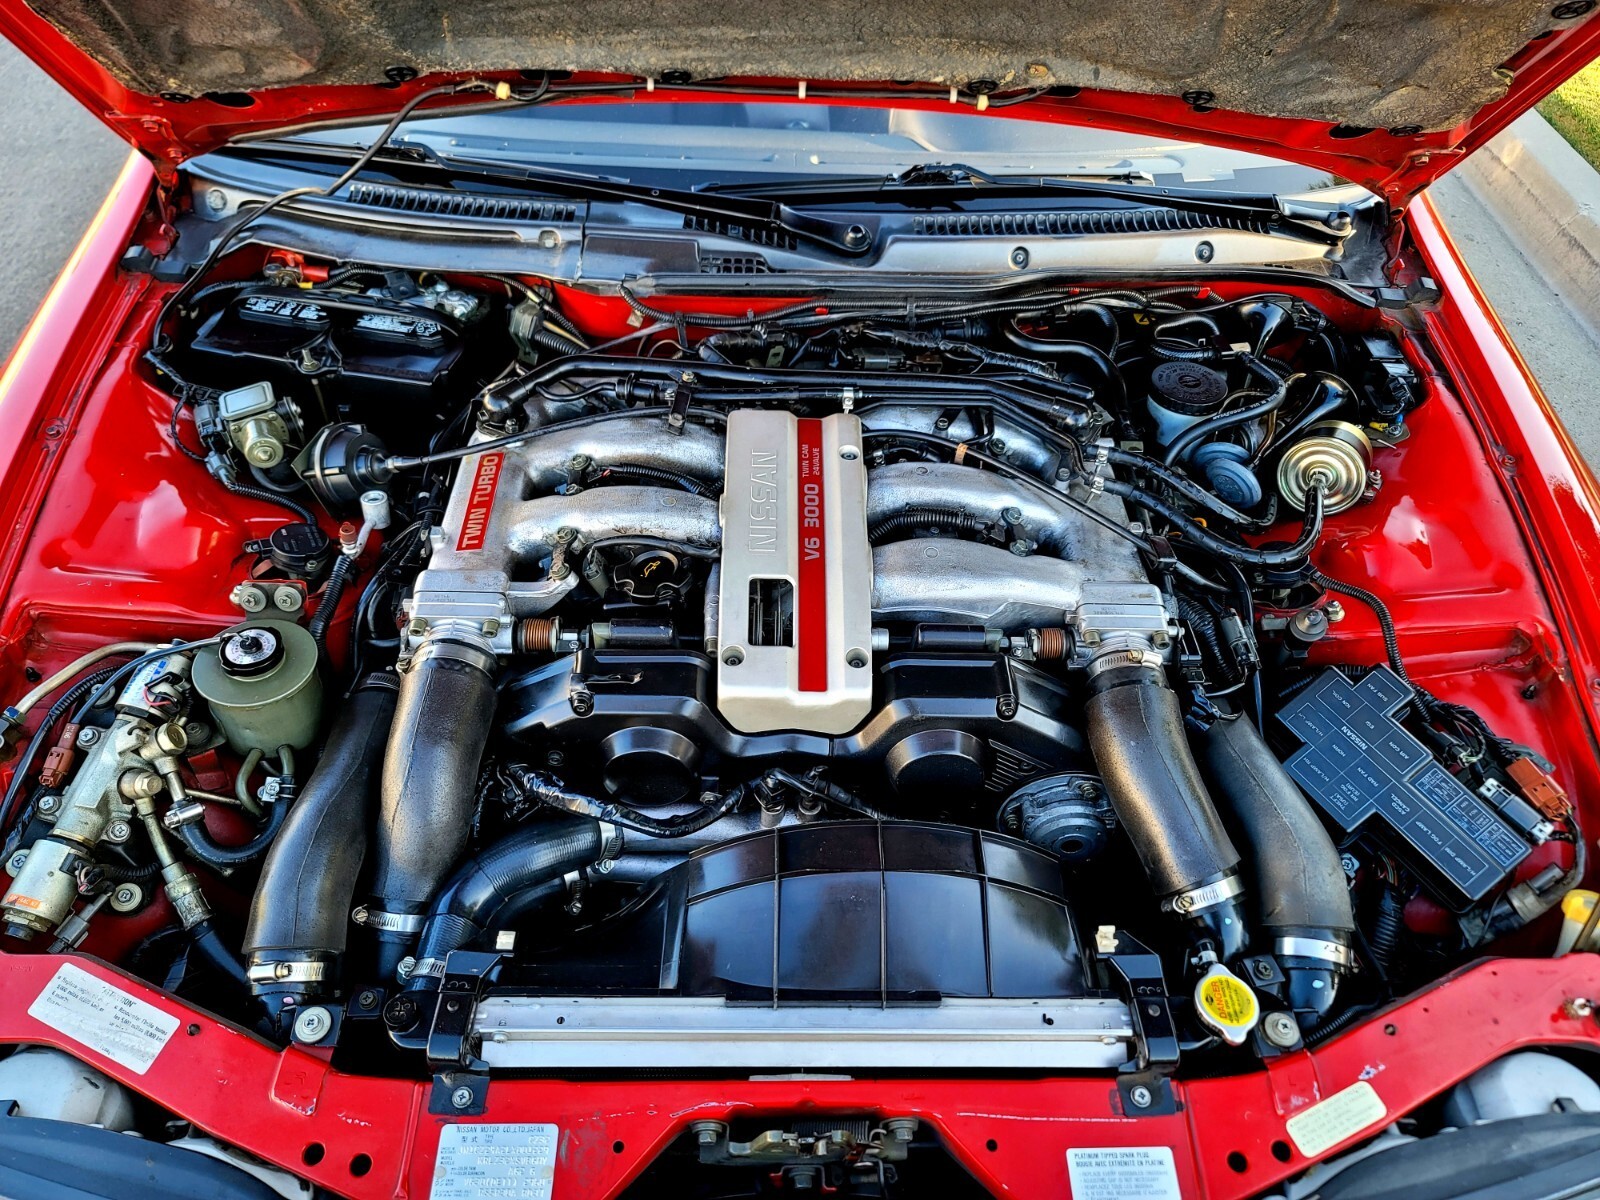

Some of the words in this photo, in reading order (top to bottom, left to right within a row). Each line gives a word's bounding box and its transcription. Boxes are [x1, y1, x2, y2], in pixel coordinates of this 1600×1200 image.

[473, 455, 499, 505] TURBO
[748, 448, 777, 554] NISSAN
[804, 483, 819, 528] 3000
[462, 507, 487, 548] TWIN
[804, 537, 820, 560] V6
[1367, 683, 1378, 693] FAN
[1377, 691, 1388, 702] SUB
[1341, 725, 1368, 750] NISSAN
[1332, 744, 1346, 757] HORN
[1389, 741, 1400, 752] CON
[1399, 750, 1410, 760] AIR
[1310, 764, 1330, 782] H/LAMP
[1357, 767, 1368, 777] FAN
[1367, 776, 1379, 787] RAD
[1391, 793, 1411, 813] CANCEL
[1391, 802, 1407, 815] ASCD
[1415, 821, 1432, 834] LAMP
[1430, 832, 1443, 846] FOG
[1454, 857, 1476, 876] H/LAMP
[1211, 981, 1227, 1019] DANGER
